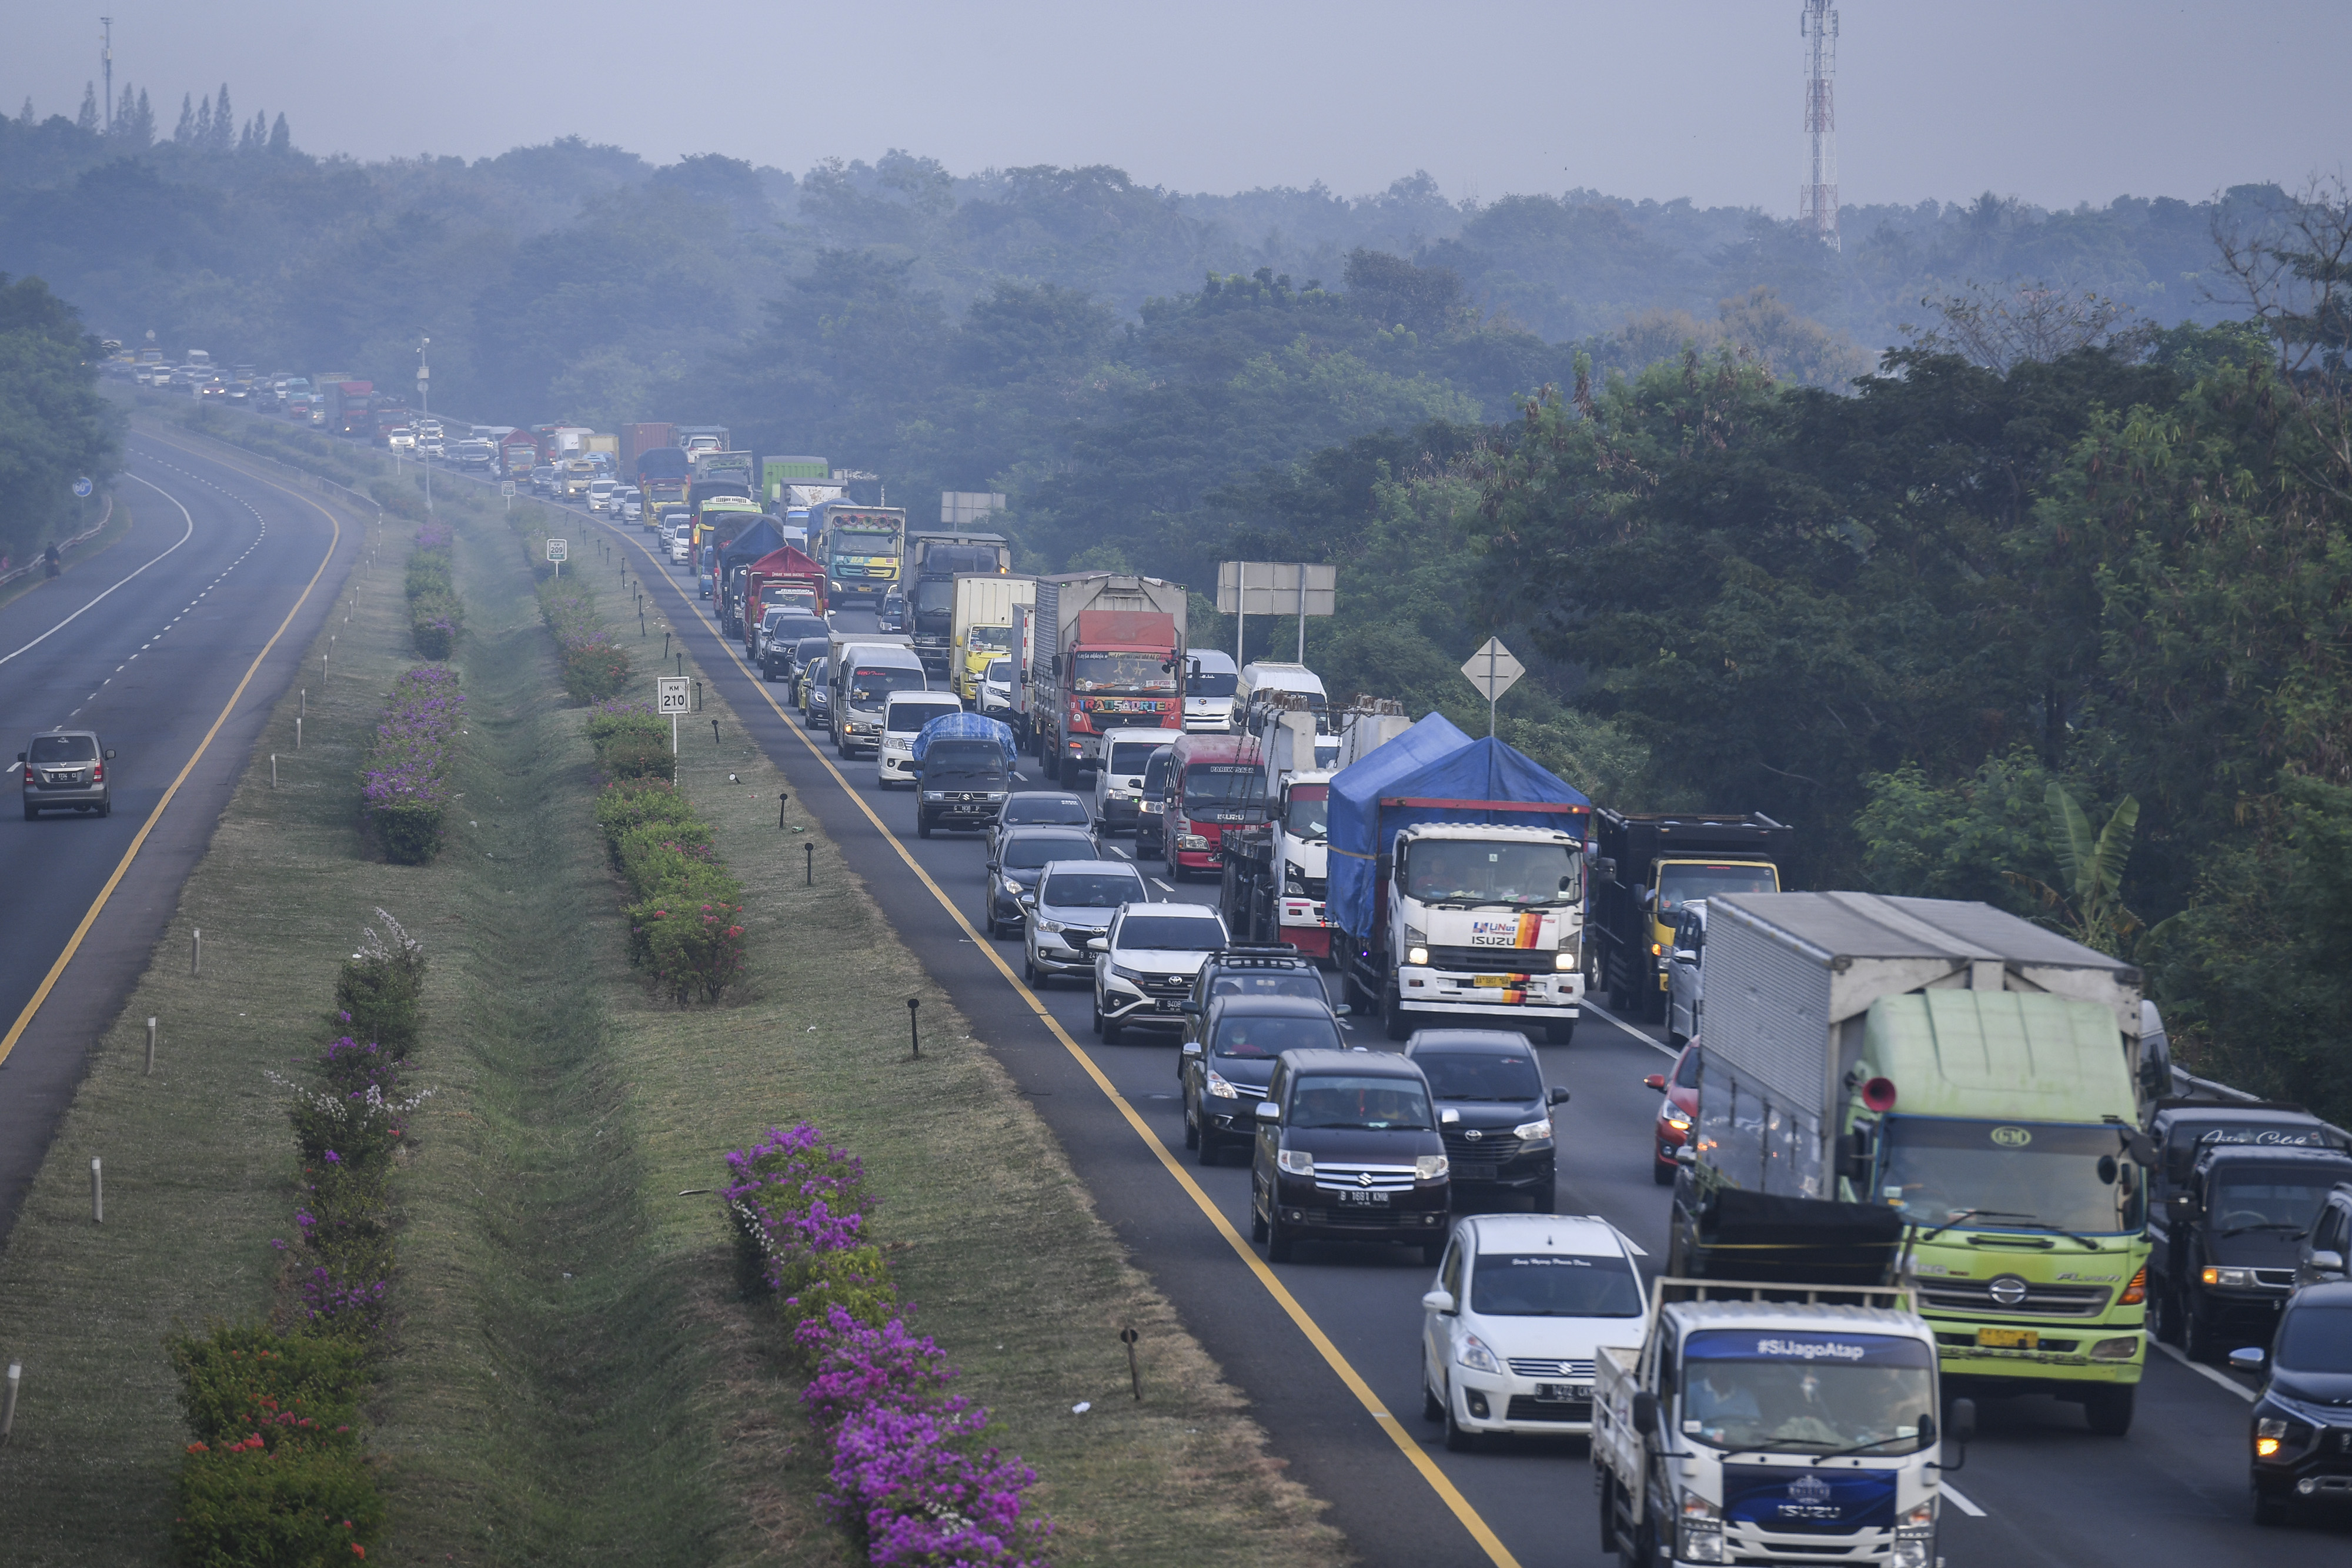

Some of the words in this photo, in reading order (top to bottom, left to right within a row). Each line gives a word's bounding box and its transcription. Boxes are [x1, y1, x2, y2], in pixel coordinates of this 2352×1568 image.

[664, 695, 684, 706] 210
[1472, 936, 1516, 946] ISUZU
[1778, 1505, 1841, 1518] ISUZU
